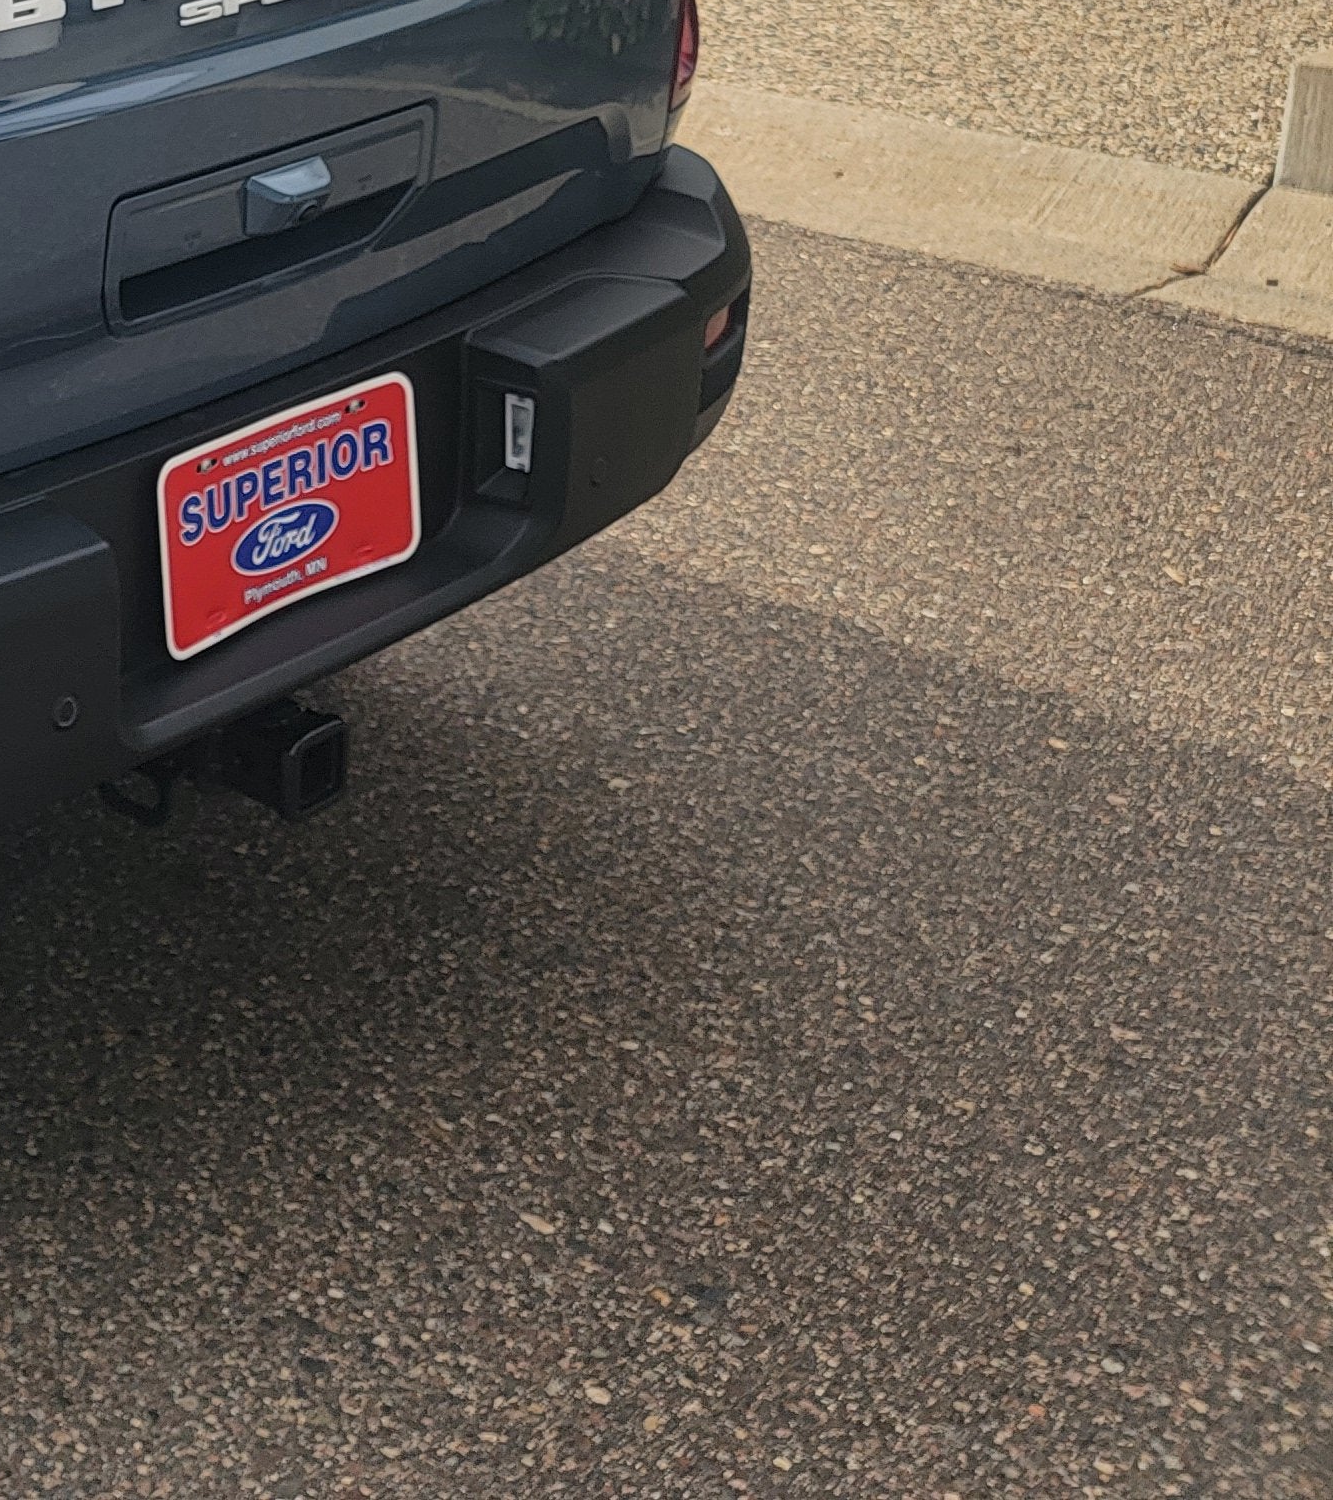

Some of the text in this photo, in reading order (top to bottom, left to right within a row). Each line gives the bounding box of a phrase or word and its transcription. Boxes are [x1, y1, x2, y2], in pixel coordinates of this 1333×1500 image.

[222, 412, 342, 467] www.superiorford.com
[180, 420, 394, 546] SUPERIOR
[252, 510, 317, 565] Ford
[304, 557, 327, 577] MN
